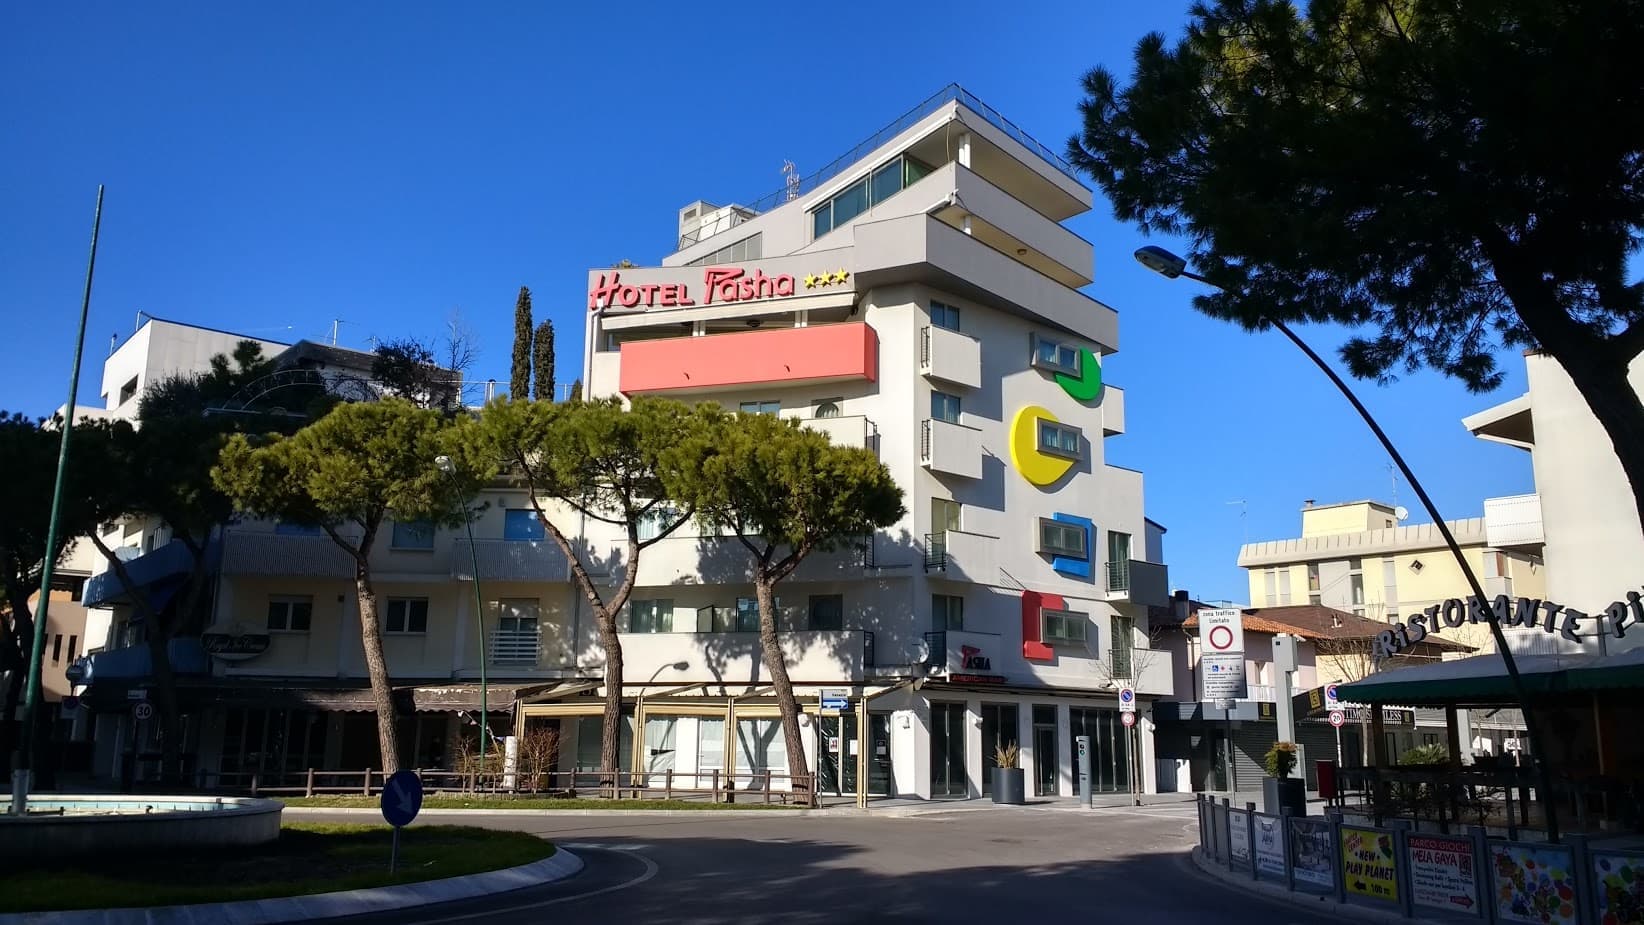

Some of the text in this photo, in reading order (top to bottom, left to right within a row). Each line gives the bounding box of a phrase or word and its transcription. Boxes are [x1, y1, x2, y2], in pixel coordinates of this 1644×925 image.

[590, 267, 795, 309] HOTEL Pasha
[1215, 609, 1235, 617] traffico
[1605, 585, 1644, 638] Pi
[138, 706, 150, 716] 30
[1410, 839, 1472, 852] PARCO GIOCHI
[1359, 850, 1376, 861] NEW
[1412, 850, 1457, 866] MELA GAYA
[1345, 862, 1363, 876] PLAY
[1365, 865, 1394, 881] PLANET
[1371, 884, 1382, 894] 100
